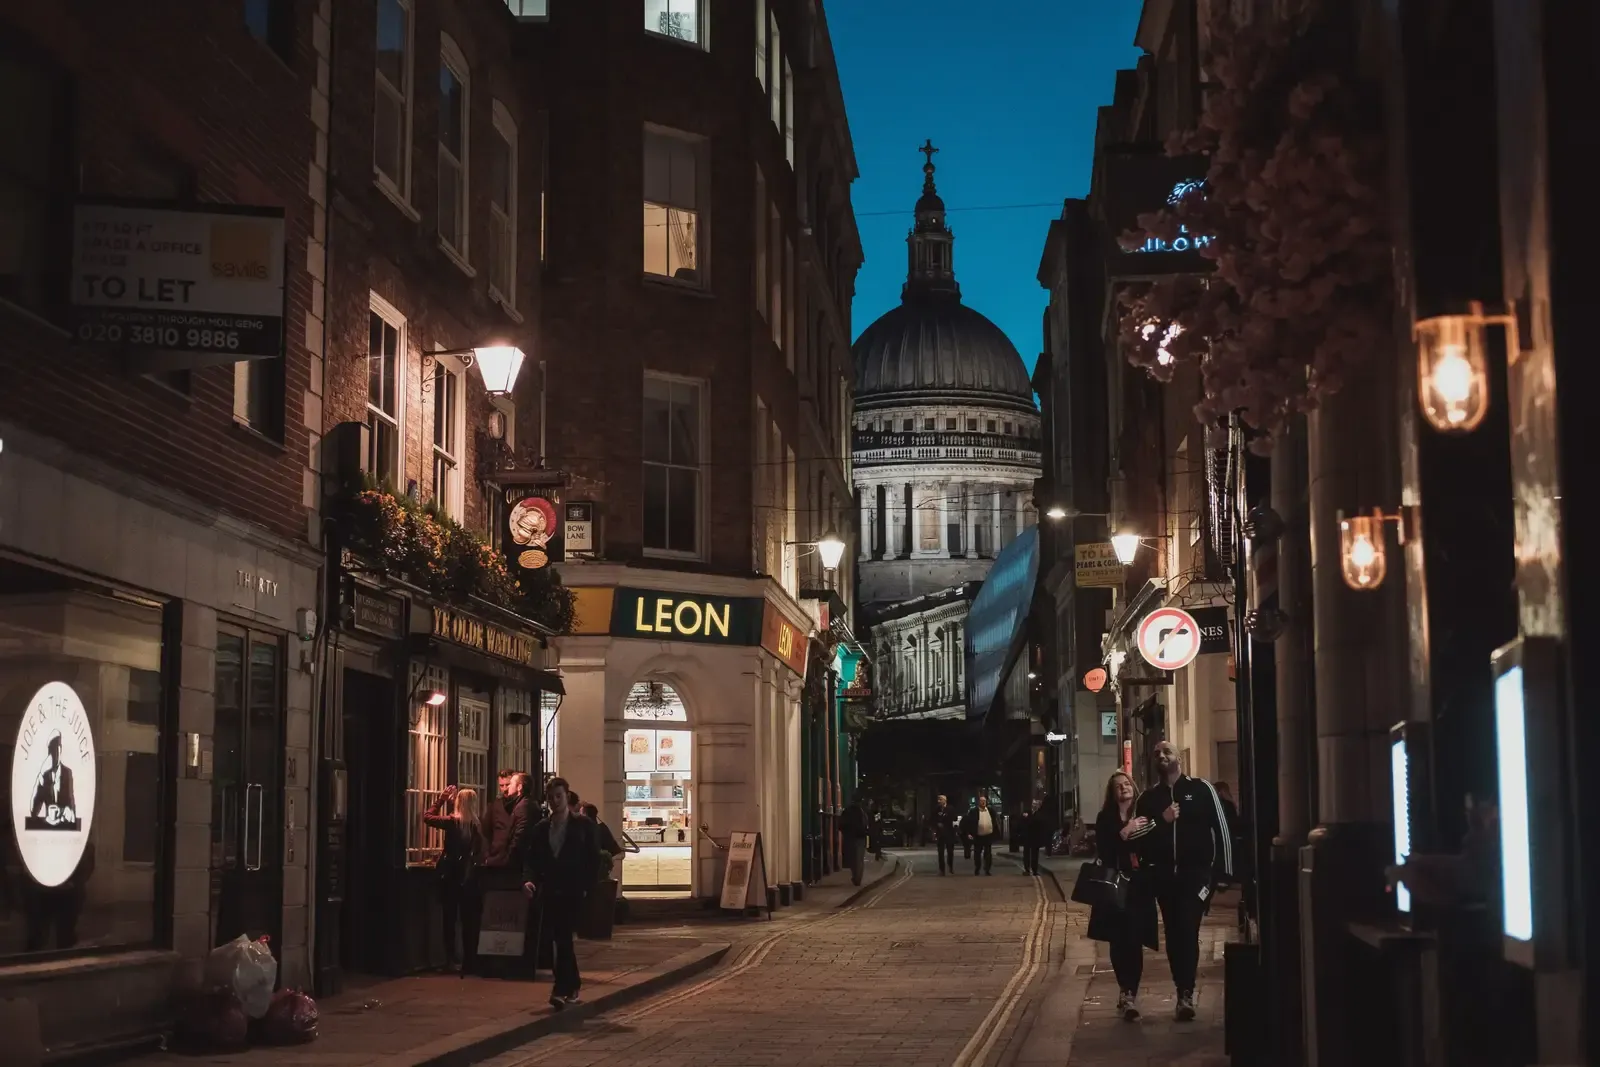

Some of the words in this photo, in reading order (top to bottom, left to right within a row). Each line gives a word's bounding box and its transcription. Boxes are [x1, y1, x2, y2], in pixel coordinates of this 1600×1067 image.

[150, 241, 203, 255] OFFICE
[212, 259, 269, 280] savills
[82, 274, 127, 300] TO
[138, 277, 197, 304] LET
[78, 323, 123, 342] 020
[129, 325, 180, 346] 3810
[186, 328, 240, 350] 9886
[235, 319, 264, 330] GENG
[1076, 560, 1096, 569] PEARL
[1080, 549, 1097, 560] TO
[236, 569, 278, 597] THIRTY
[635, 596, 731, 637] LEON
[432, 604, 450, 639] YE
[453, 615, 484, 650] OLDE
[487, 624, 532, 665] WATLING
[779, 621, 793, 661] LEON
[1199, 625, 1224, 637] NES
[20, 715, 38, 761] JOE
[37, 703, 47, 724] &
[47, 694, 69, 719] THE
[68, 710, 91, 765] JUICE
